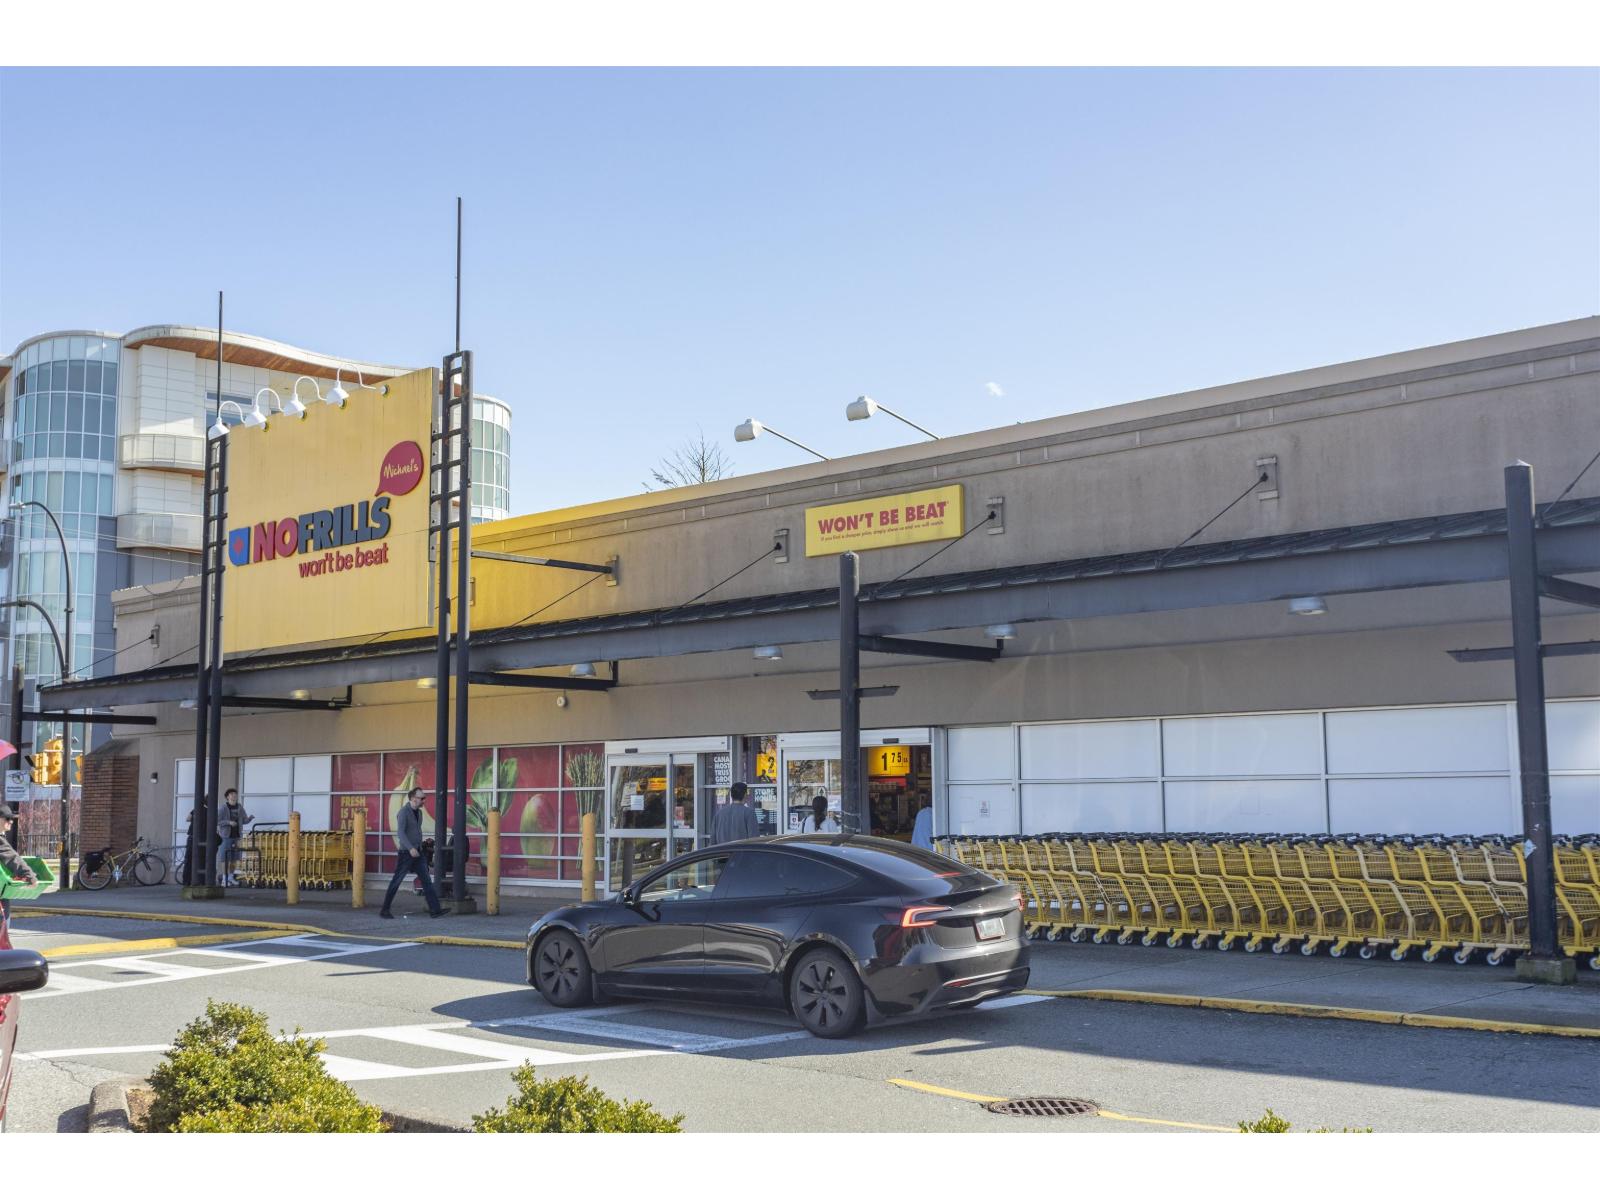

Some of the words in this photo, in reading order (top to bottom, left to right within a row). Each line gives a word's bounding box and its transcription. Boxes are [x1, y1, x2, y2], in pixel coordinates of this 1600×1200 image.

[383, 458, 419, 479] Michael's
[818, 512, 874, 535] WON'T
[879, 508, 899, 526] BE
[299, 551, 334, 578] won't
[335, 550, 353, 572] be
[355, 543, 389, 569] beat
[714, 755, 730, 763] CANA
[341, 795, 366, 808] FRESH
[340, 807, 349, 819] IS
[351, 807, 368, 819] NT
